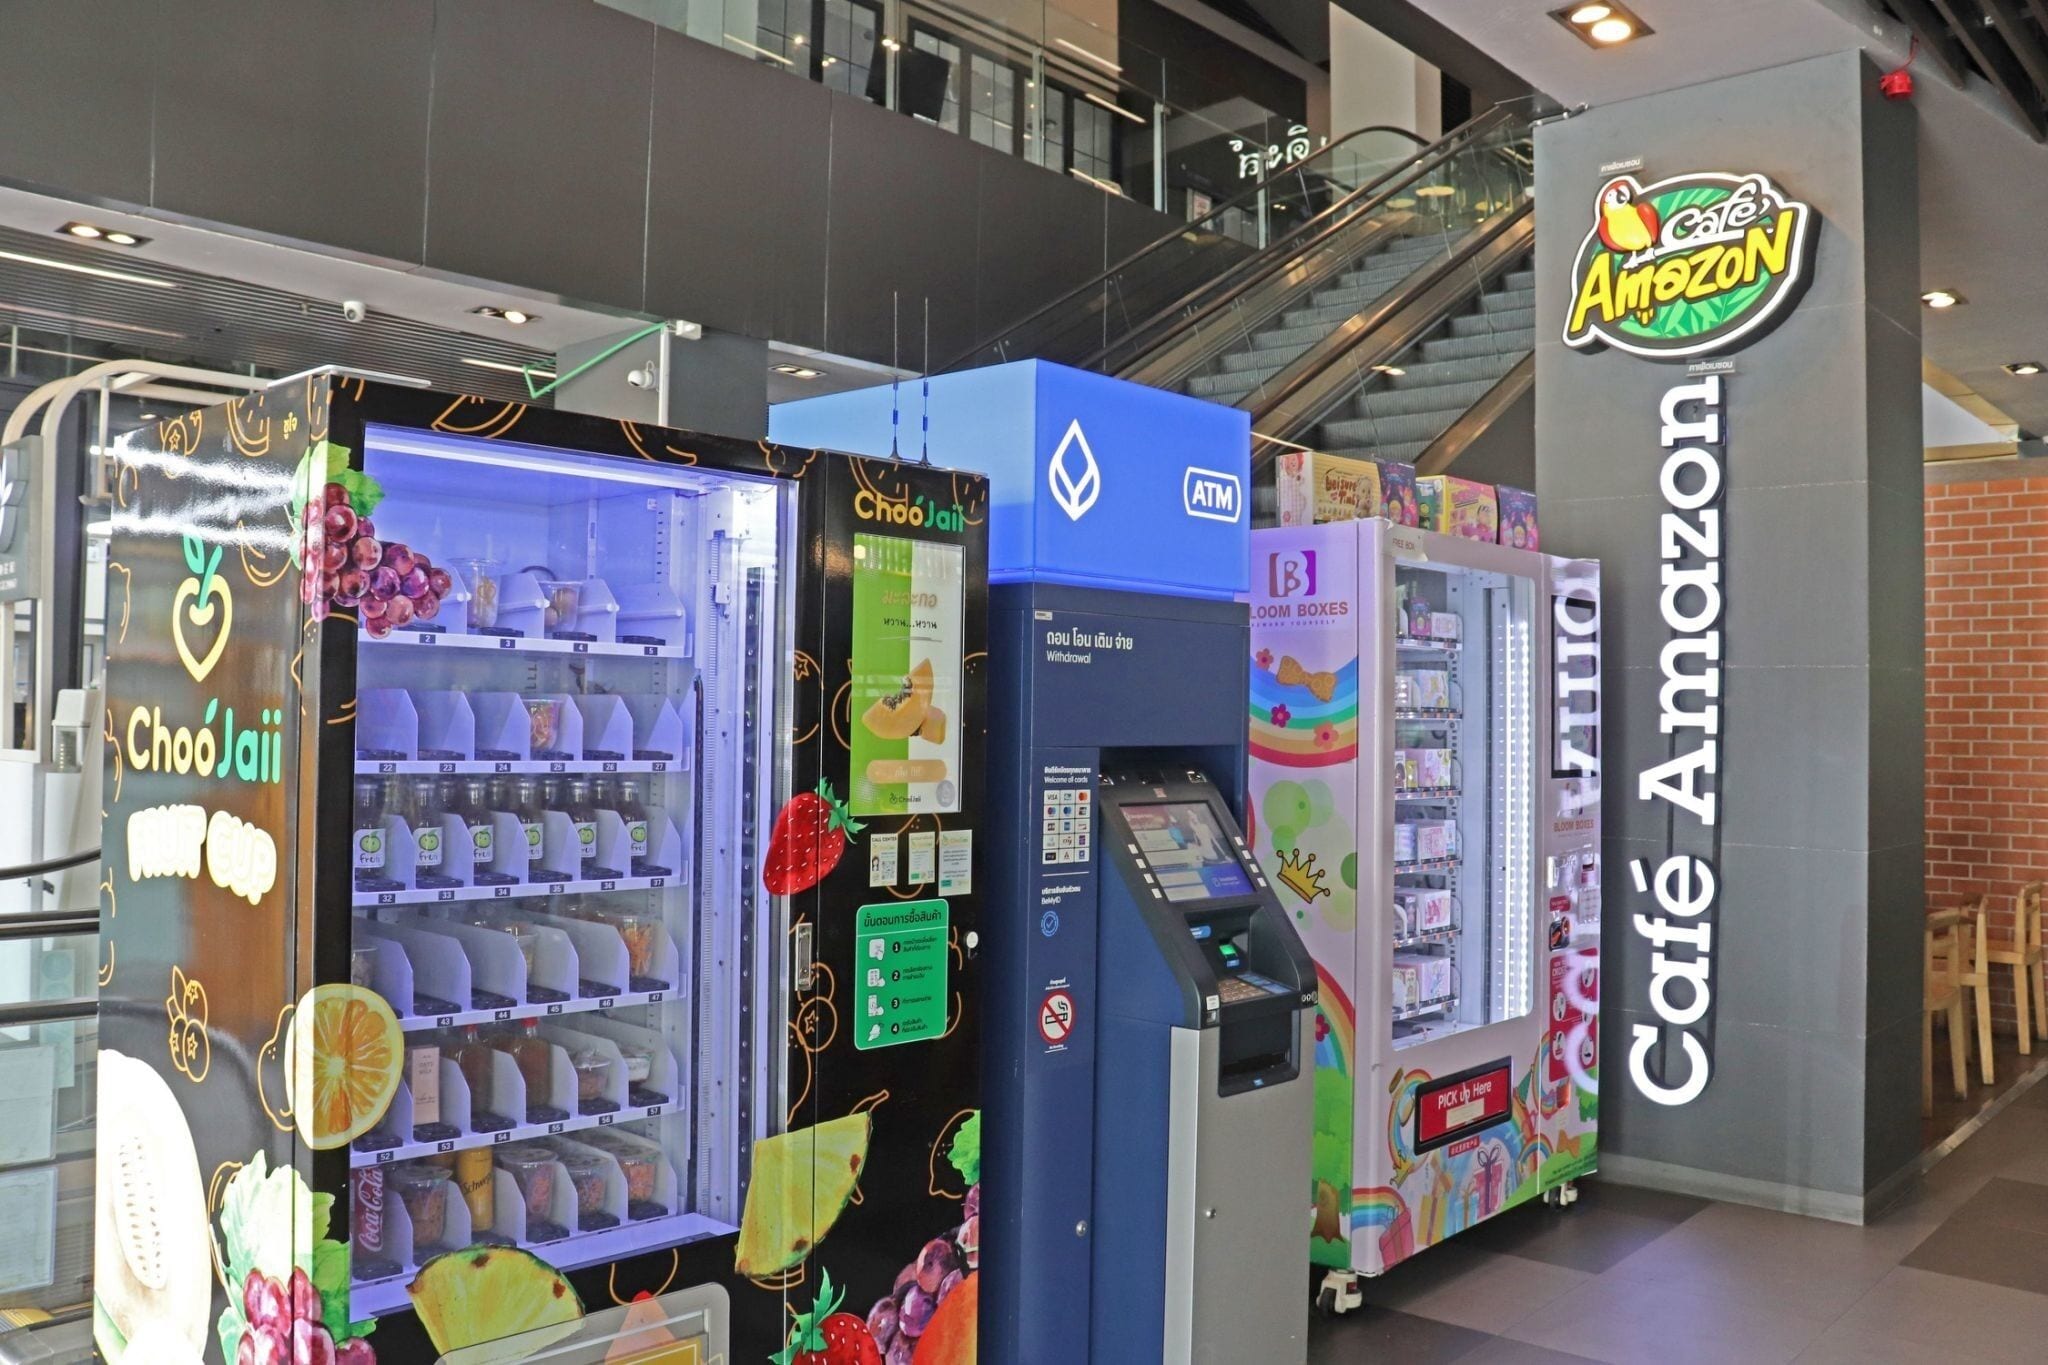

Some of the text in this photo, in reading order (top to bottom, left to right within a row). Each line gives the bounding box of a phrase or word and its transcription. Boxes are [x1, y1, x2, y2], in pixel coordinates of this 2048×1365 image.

[1192, 479, 1233, 511] ATM
[1297, 601, 1349, 617] BOXES
[425, 635, 431, 643] 2
[578, 643, 584, 651] 4
[648, 647, 654, 655] 5
[1046, 626, 1133, 650] ถอน โอน เติม จ่าย
[1046, 650, 1092, 664] Withdrawal
[1629, 375, 1720, 1106] Café Amazon
[553, 763, 562, 771] 25
[606, 763, 615, 771] 26
[655, 763, 664, 771] 27
[498, 888, 508, 896] 34
[604, 882, 613, 890] 36
[864, 910, 942, 928] ขั้นตอนการซื้อสินค้า
[441, 1018, 450, 1026] 43
[550, 1005, 560, 1013] 45
[602, 999, 611, 1007] 46
[1438, 1091, 1458, 1110] PICK
[1473, 1081, 1492, 1098] Here
[498, 1133, 508, 1141] 54
[551, 1124, 560, 1132] 55
[602, 1116, 611, 1124] 56
